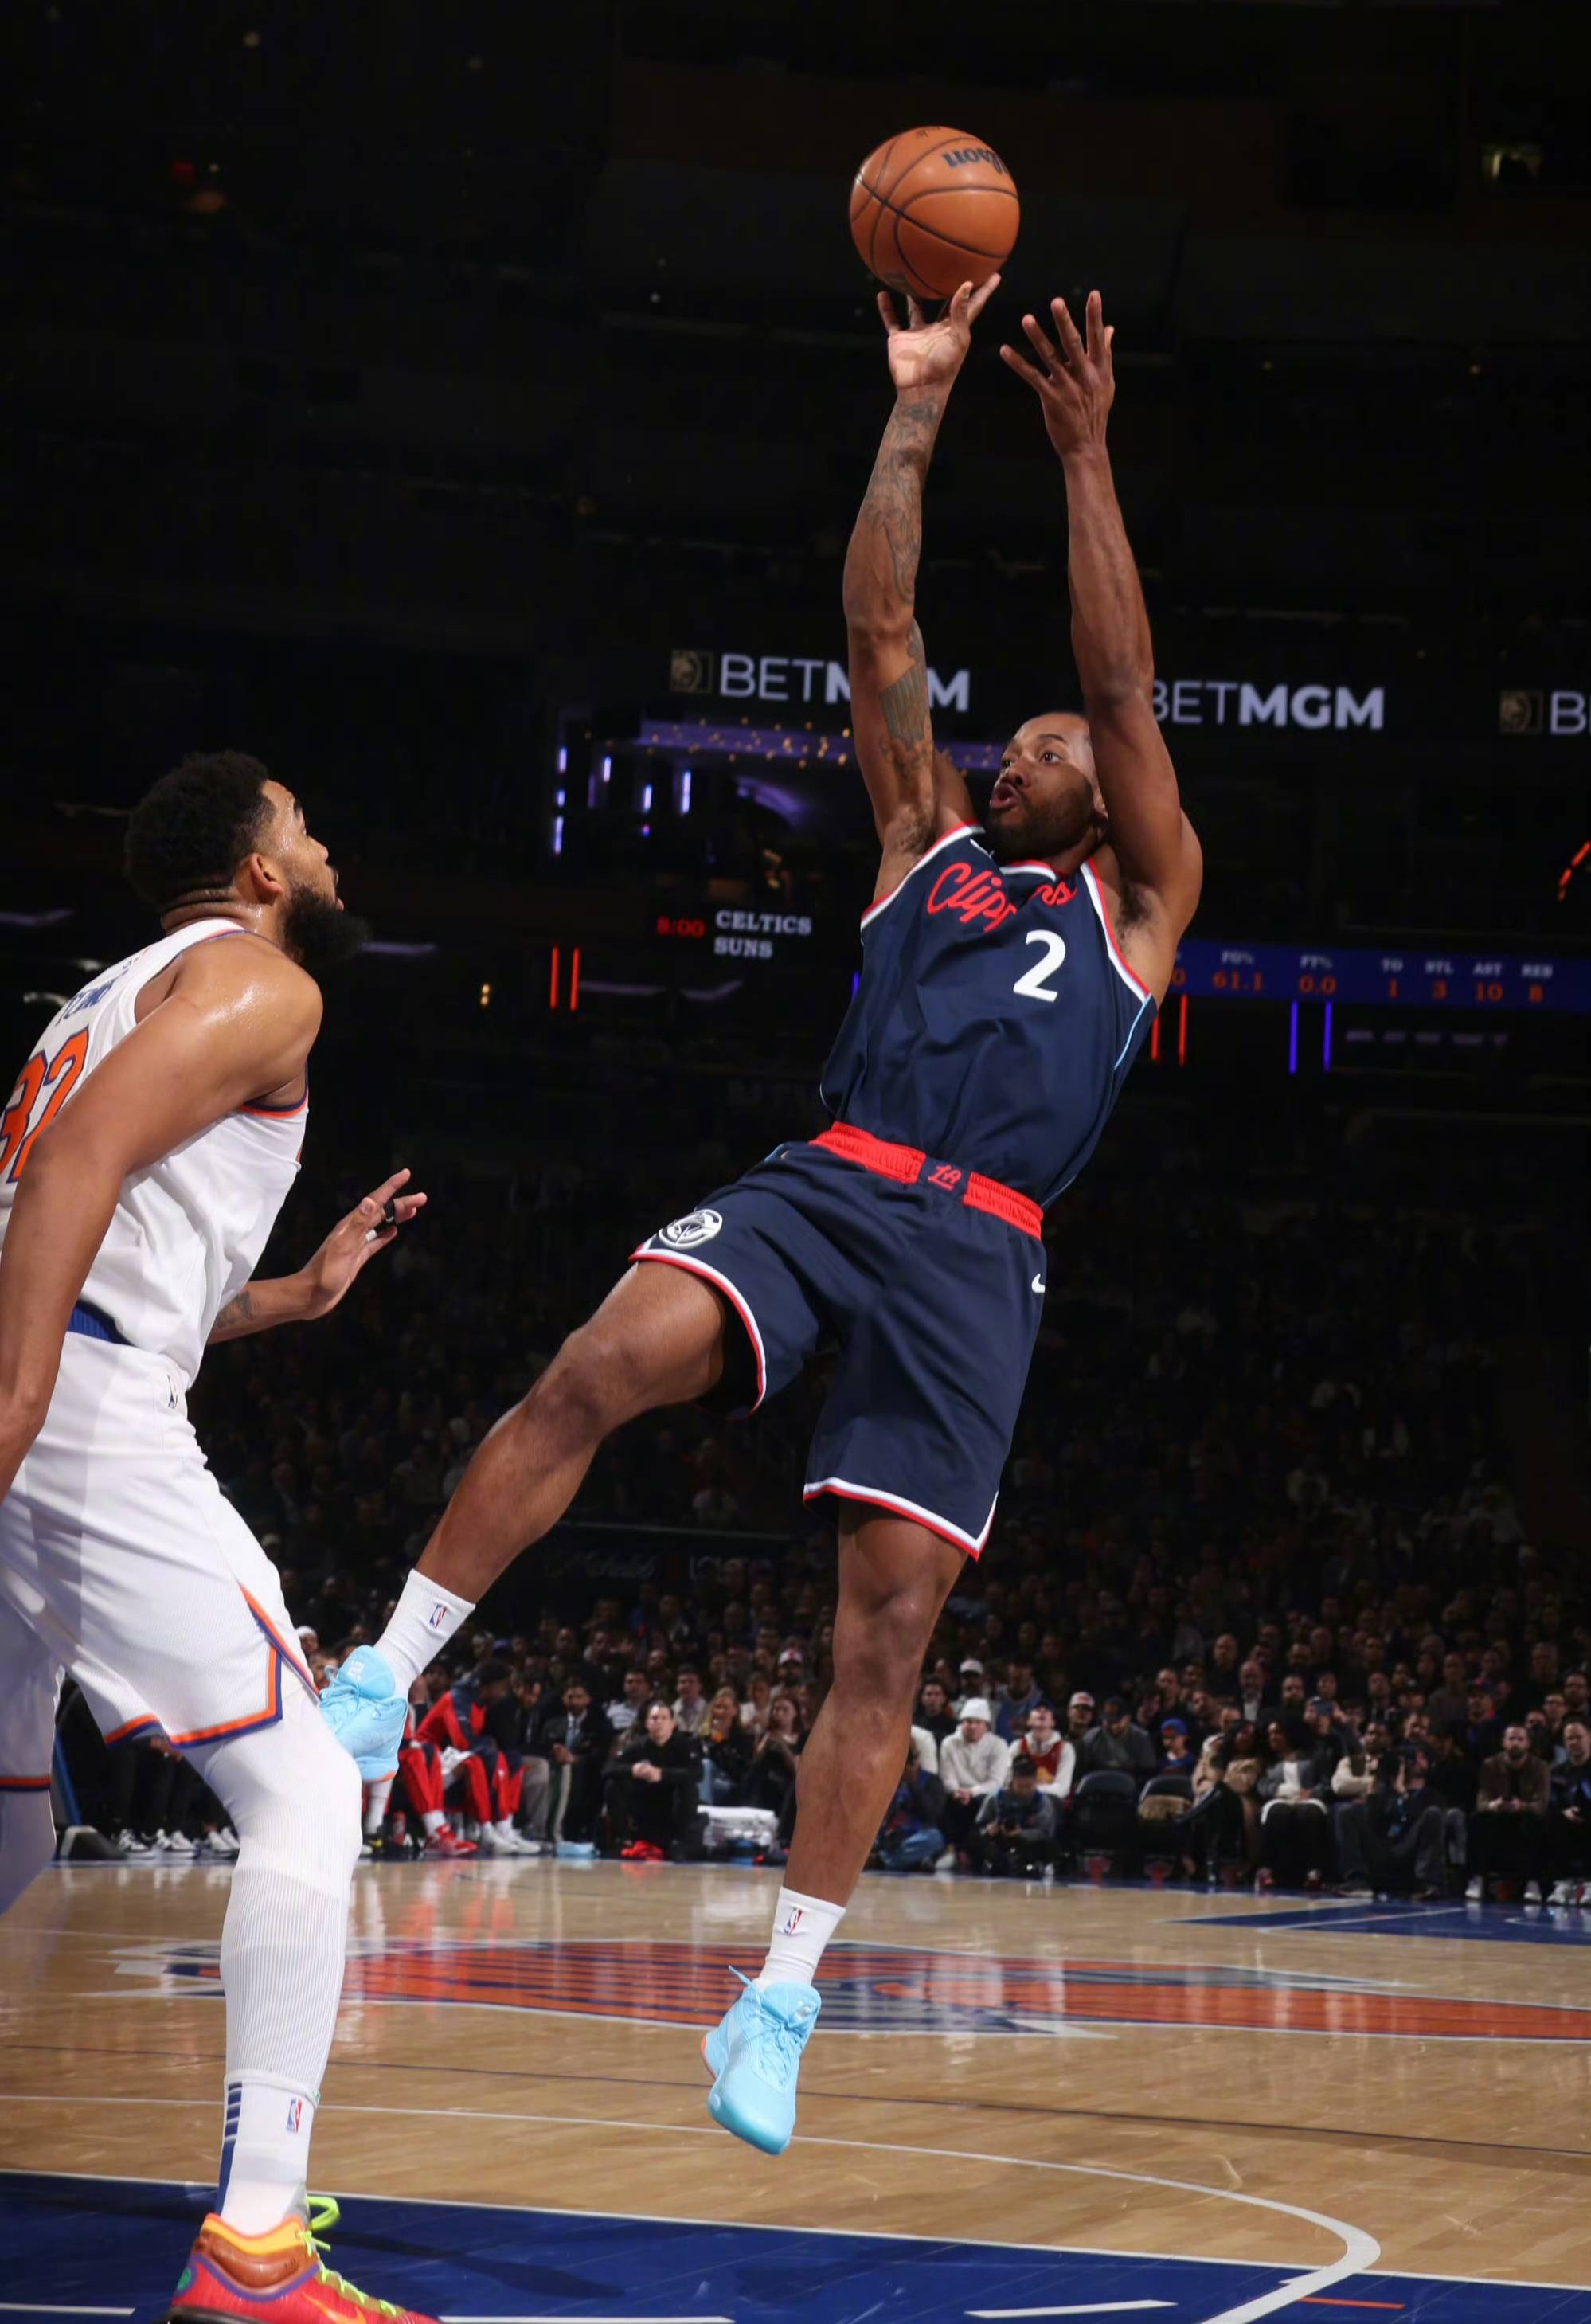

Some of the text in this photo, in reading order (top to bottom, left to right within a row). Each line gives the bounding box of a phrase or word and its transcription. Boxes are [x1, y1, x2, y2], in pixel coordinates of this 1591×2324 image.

[720, 653, 971, 712] BETMM
[927, 862, 1077, 933] Clipprs
[657, 916, 706, 938] 8:00
[715, 910, 812, 936] CELTICS
[714, 936, 772, 959] SUNS
[1013, 929, 1066, 1003] 2
[1212, 969, 1263, 992] 61.1
[1298, 974, 1338, 995] 0.0
[1388, 976, 1399, 1000] 1
[1476, 980, 1504, 1004] 10
[0, 1025, 90, 1184] 32
